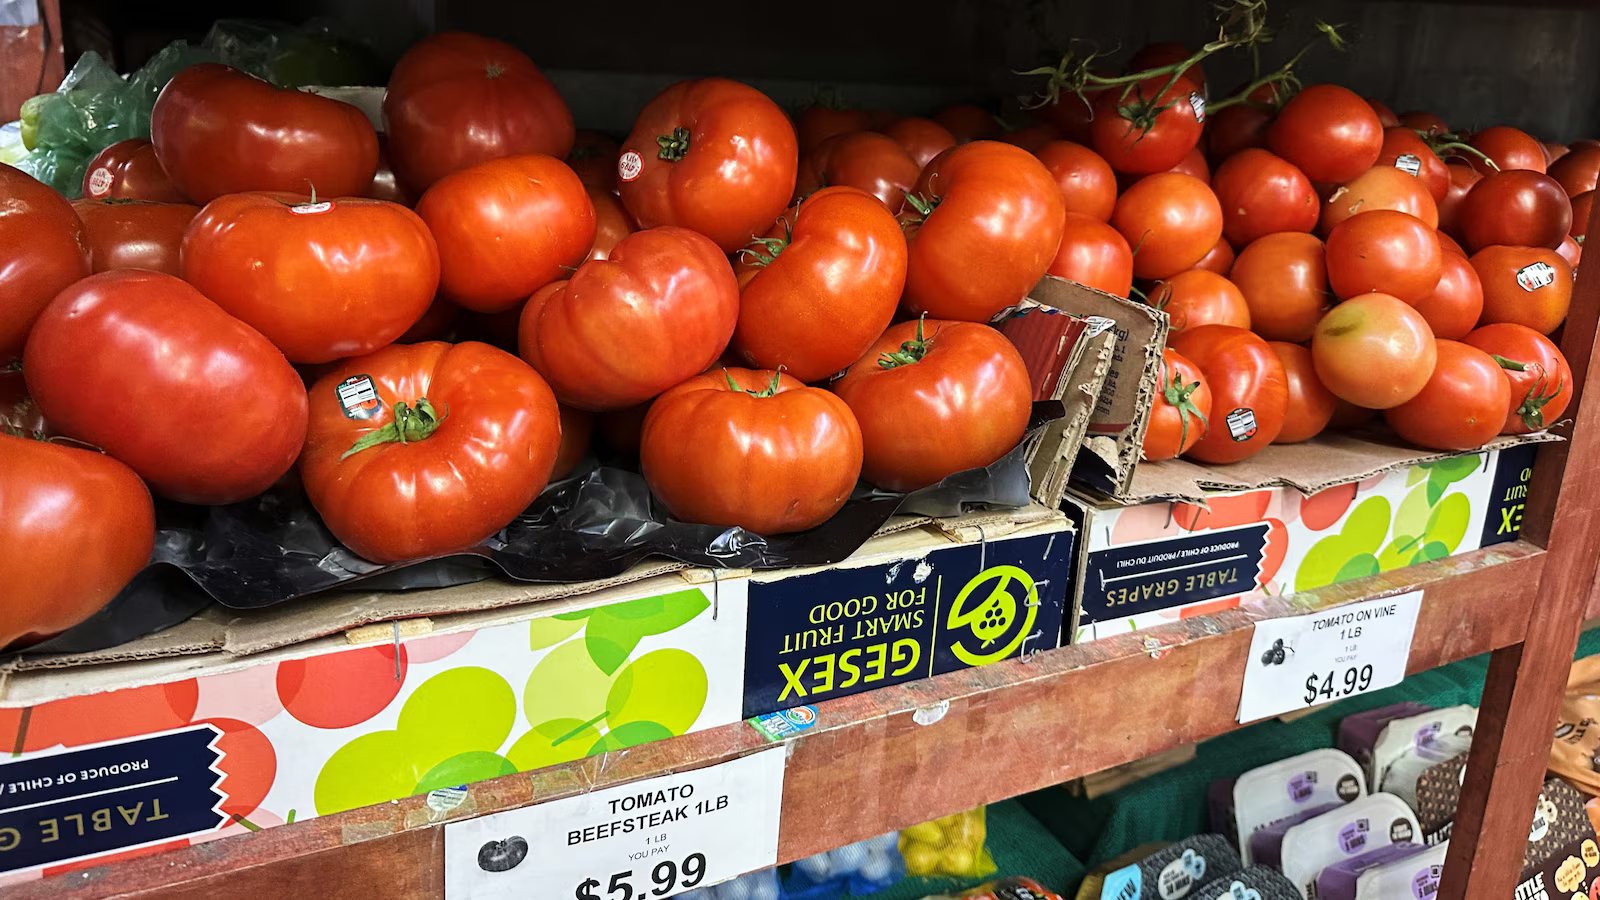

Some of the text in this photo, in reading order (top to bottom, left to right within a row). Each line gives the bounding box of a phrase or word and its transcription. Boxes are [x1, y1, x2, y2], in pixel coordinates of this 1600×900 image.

[1503, 484, 1528, 502] RUIT
[1181, 547, 1199, 558] CHILE
[1199, 546, 1209, 555] OF
[1209, 541, 1239, 553] PRODUCE
[1135, 556, 1146, 566] DU
[1105, 567, 1238, 608] TABLE GRAPES
[809, 587, 926, 624] FOR GOOD
[1312, 604, 1397, 631] TOMATO ON VINE
[779, 609, 924, 654] SMART FRUIT
[1340, 627, 1362, 640] 1 LB
[777, 638, 921, 702] GESEX
[1303, 663, 1373, 706] $4.99
[56, 772, 77, 785] OF
[80, 758, 149, 781] PRODUCE
[9, 776, 53, 793] CHILE
[608, 783, 695, 815] TOMATO
[39, 798, 169, 843] TABLE
[567, 794, 729, 846] BEEFSTEAK 1LB
[655, 832, 667, 843] LB
[627, 844, 670, 861] YOU PAY
[575, 852, 707, 900] $5.99
